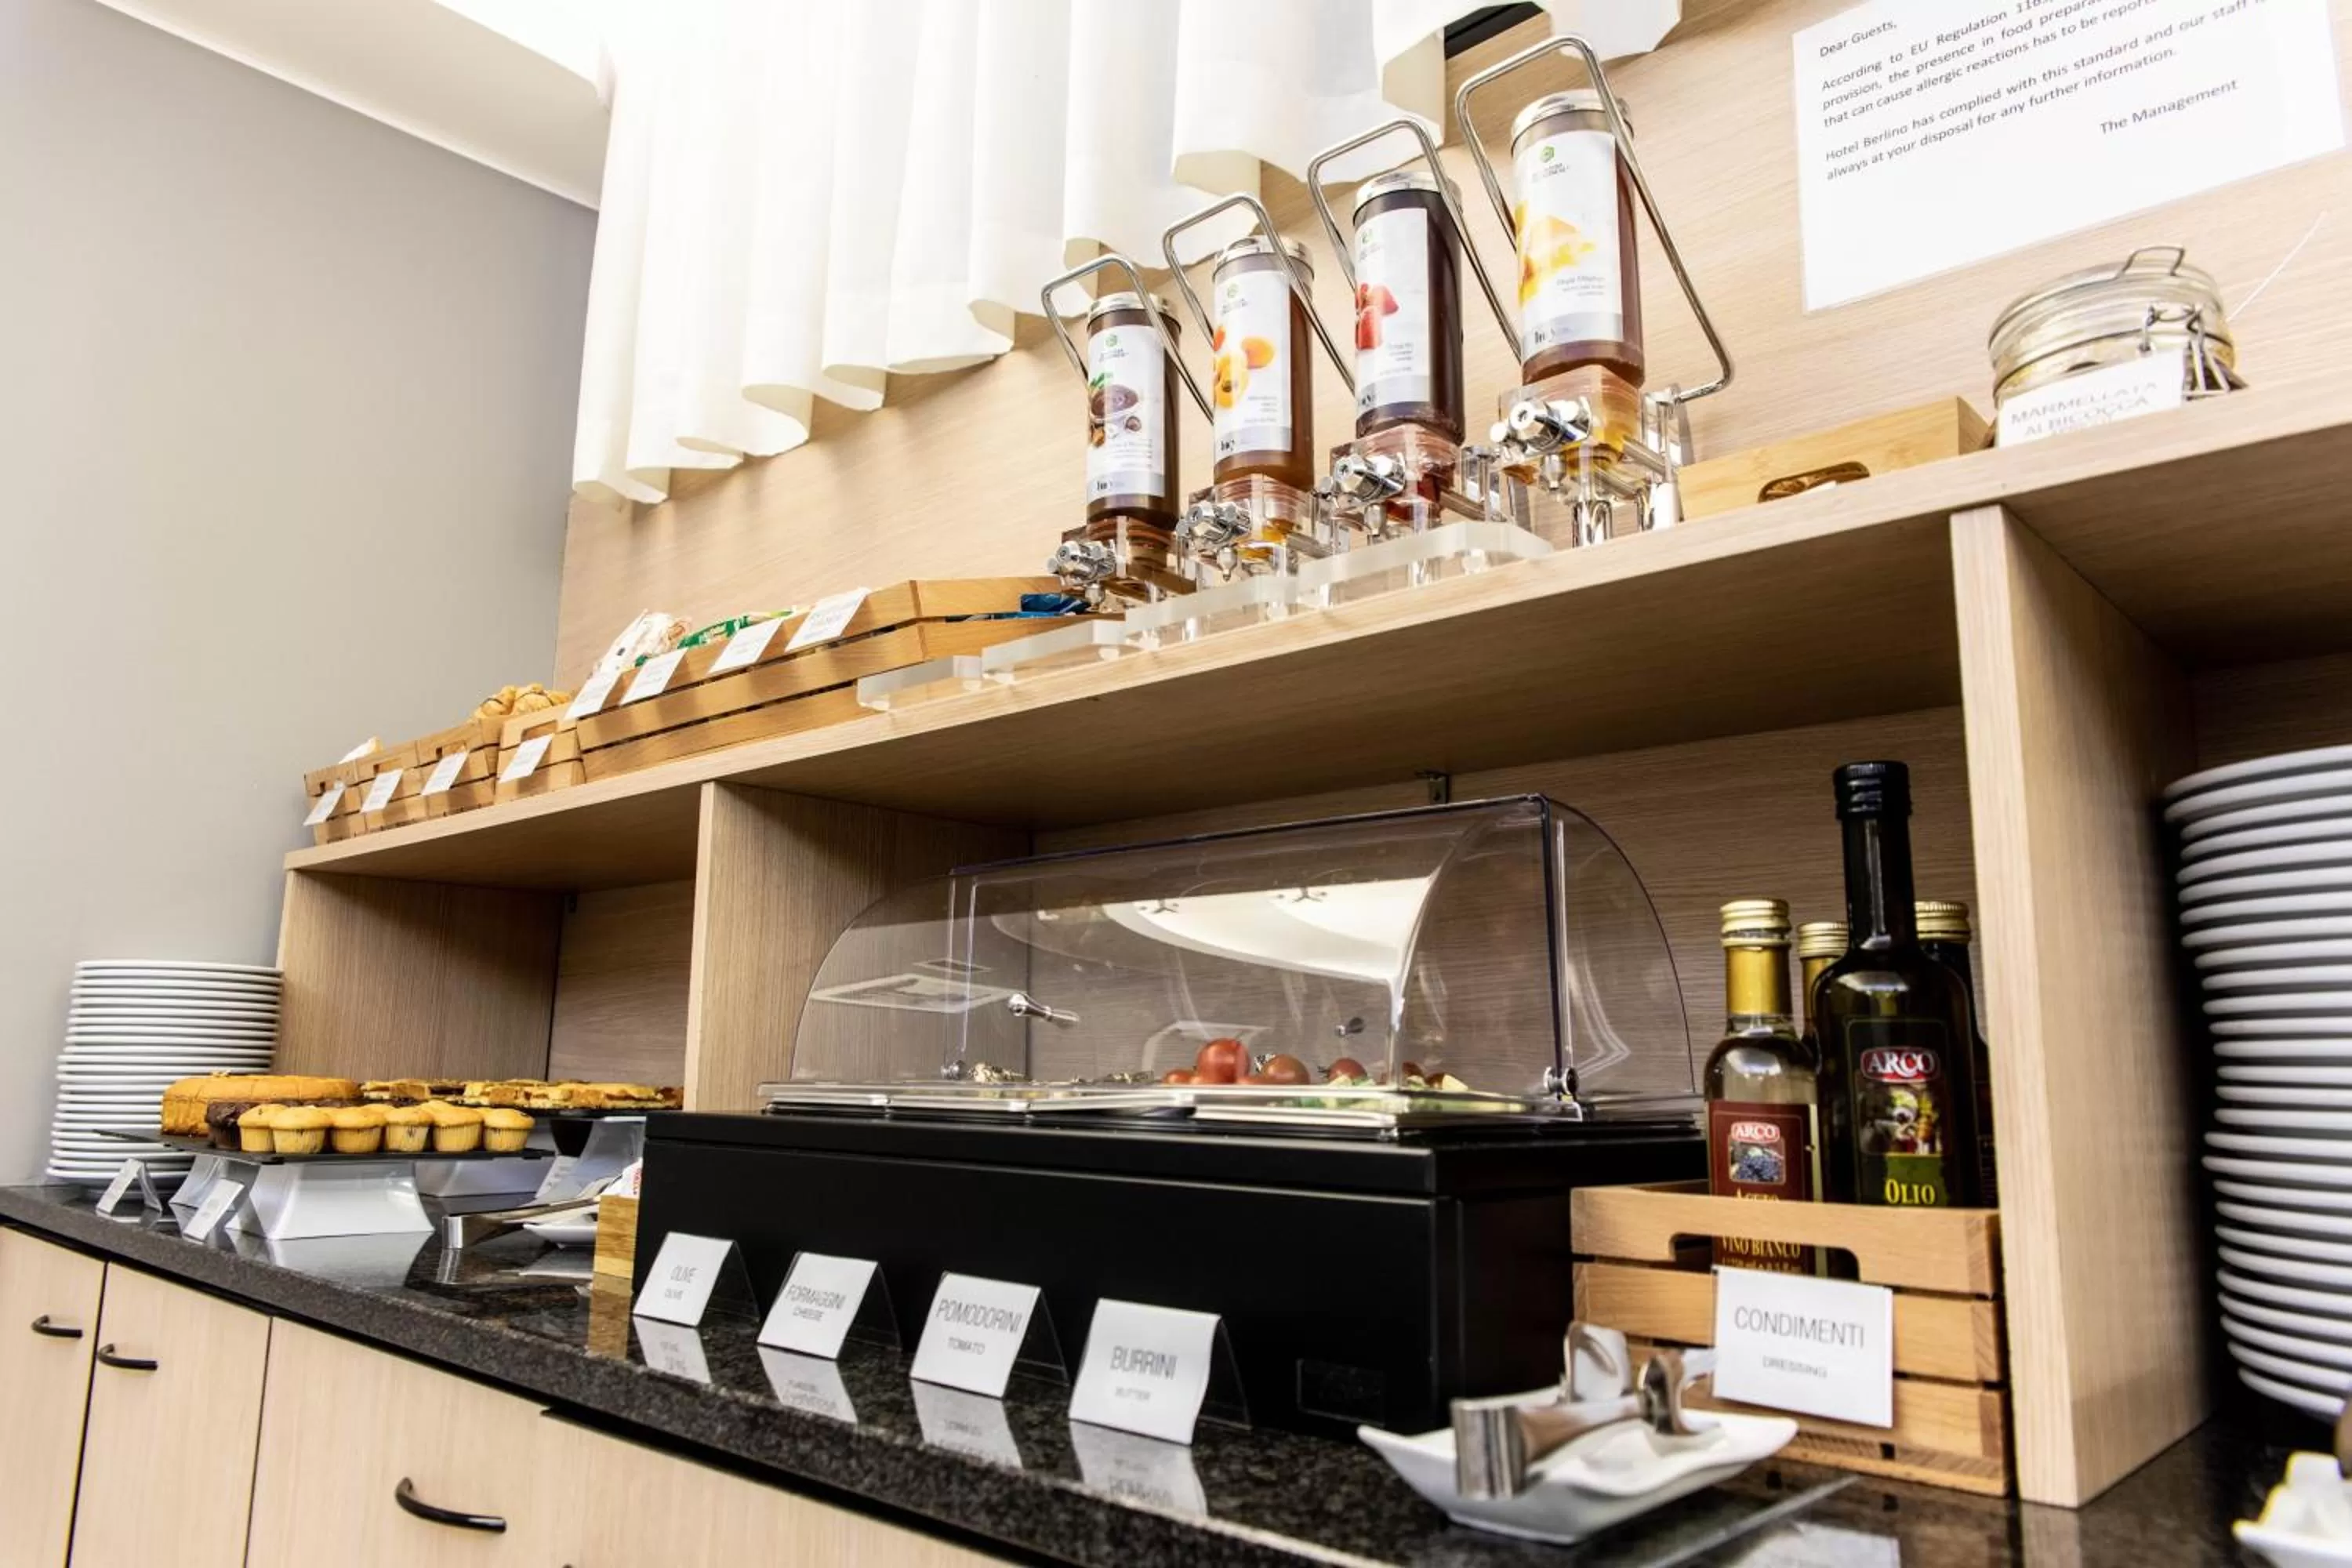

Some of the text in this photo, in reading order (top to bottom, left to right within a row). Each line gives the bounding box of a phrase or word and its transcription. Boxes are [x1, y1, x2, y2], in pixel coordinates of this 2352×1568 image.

[1820, 21, 1897, 57] Dear Guests,
[1822, 60, 1882, 92] According
[1889, 52, 1903, 64] to
[1911, 41, 1929, 56] EU
[1936, 10, 2007, 45] Regulation
[1822, 81, 1882, 111] provision,
[1889, 68, 1910, 83] the
[1915, 43, 1975, 74] presence
[1982, 34, 1994, 48] in
[2002, 19, 2033, 39] food
[1824, 111, 1848, 128] that
[1853, 103, 1874, 118] can
[1876, 87, 1913, 108] cause
[1916, 68, 1963, 93] allergic
[1966, 41, 2030, 74] reactions
[2033, 33, 2057, 48] has
[2061, 24, 2077, 36] to
[2080, 16, 2098, 30] be
[1825, 141, 1860, 162] Hotel
[1864, 124, 1908, 148] Berlino
[1912, 114, 1935, 130] has
[1940, 88, 2002, 121] complied
[2007, 77, 2037, 96] with
[2042, 64, 2068, 82] this
[2074, 37, 2139, 71] standard
[2144, 24, 2174, 45] and
[2180, 14, 2206, 32] our
[1827, 48, 2176, 180] always at your disposal for any further information.
[2100, 78, 2238, 135] The Management
[1867, 1048, 1936, 1080] ARCO
[1734, 1125, 1777, 1139] ARCO
[1885, 1178, 1936, 1206] OLIO
[1752, 1240, 1801, 1258] BIANCO
[935, 1298, 1022, 1334] POMODORINI
[1734, 1306, 1864, 1348] CONDIMENTI
[948, 1337, 985, 1356] TOMATO
[1110, 1345, 1178, 1380] BURRINI
